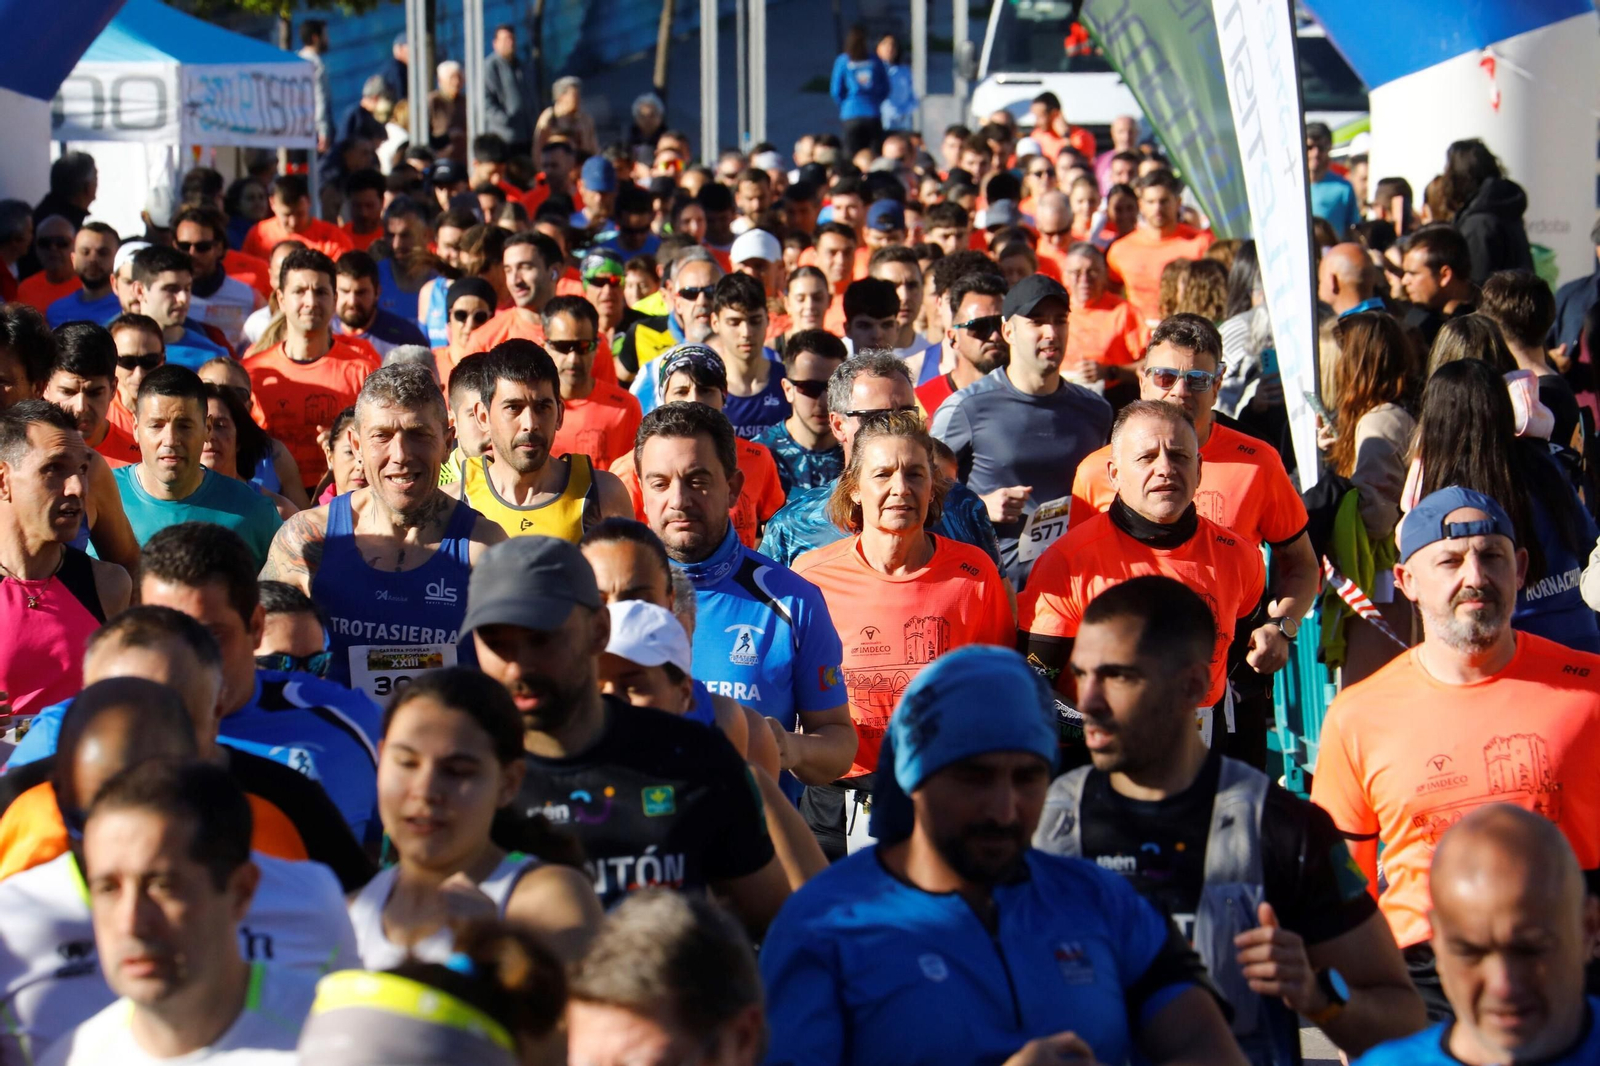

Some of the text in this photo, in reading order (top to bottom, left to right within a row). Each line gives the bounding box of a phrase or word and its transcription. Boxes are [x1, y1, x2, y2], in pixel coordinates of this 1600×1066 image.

[1031, 521, 1069, 542] 577
[424, 577, 458, 602] als
[330, 616, 459, 645] TROTASIERRA
[860, 645, 891, 653] IMDECO
[702, 680, 762, 702] ERRA
[853, 716, 892, 728] CARRE
[1427, 774, 1469, 790] IMDECO
